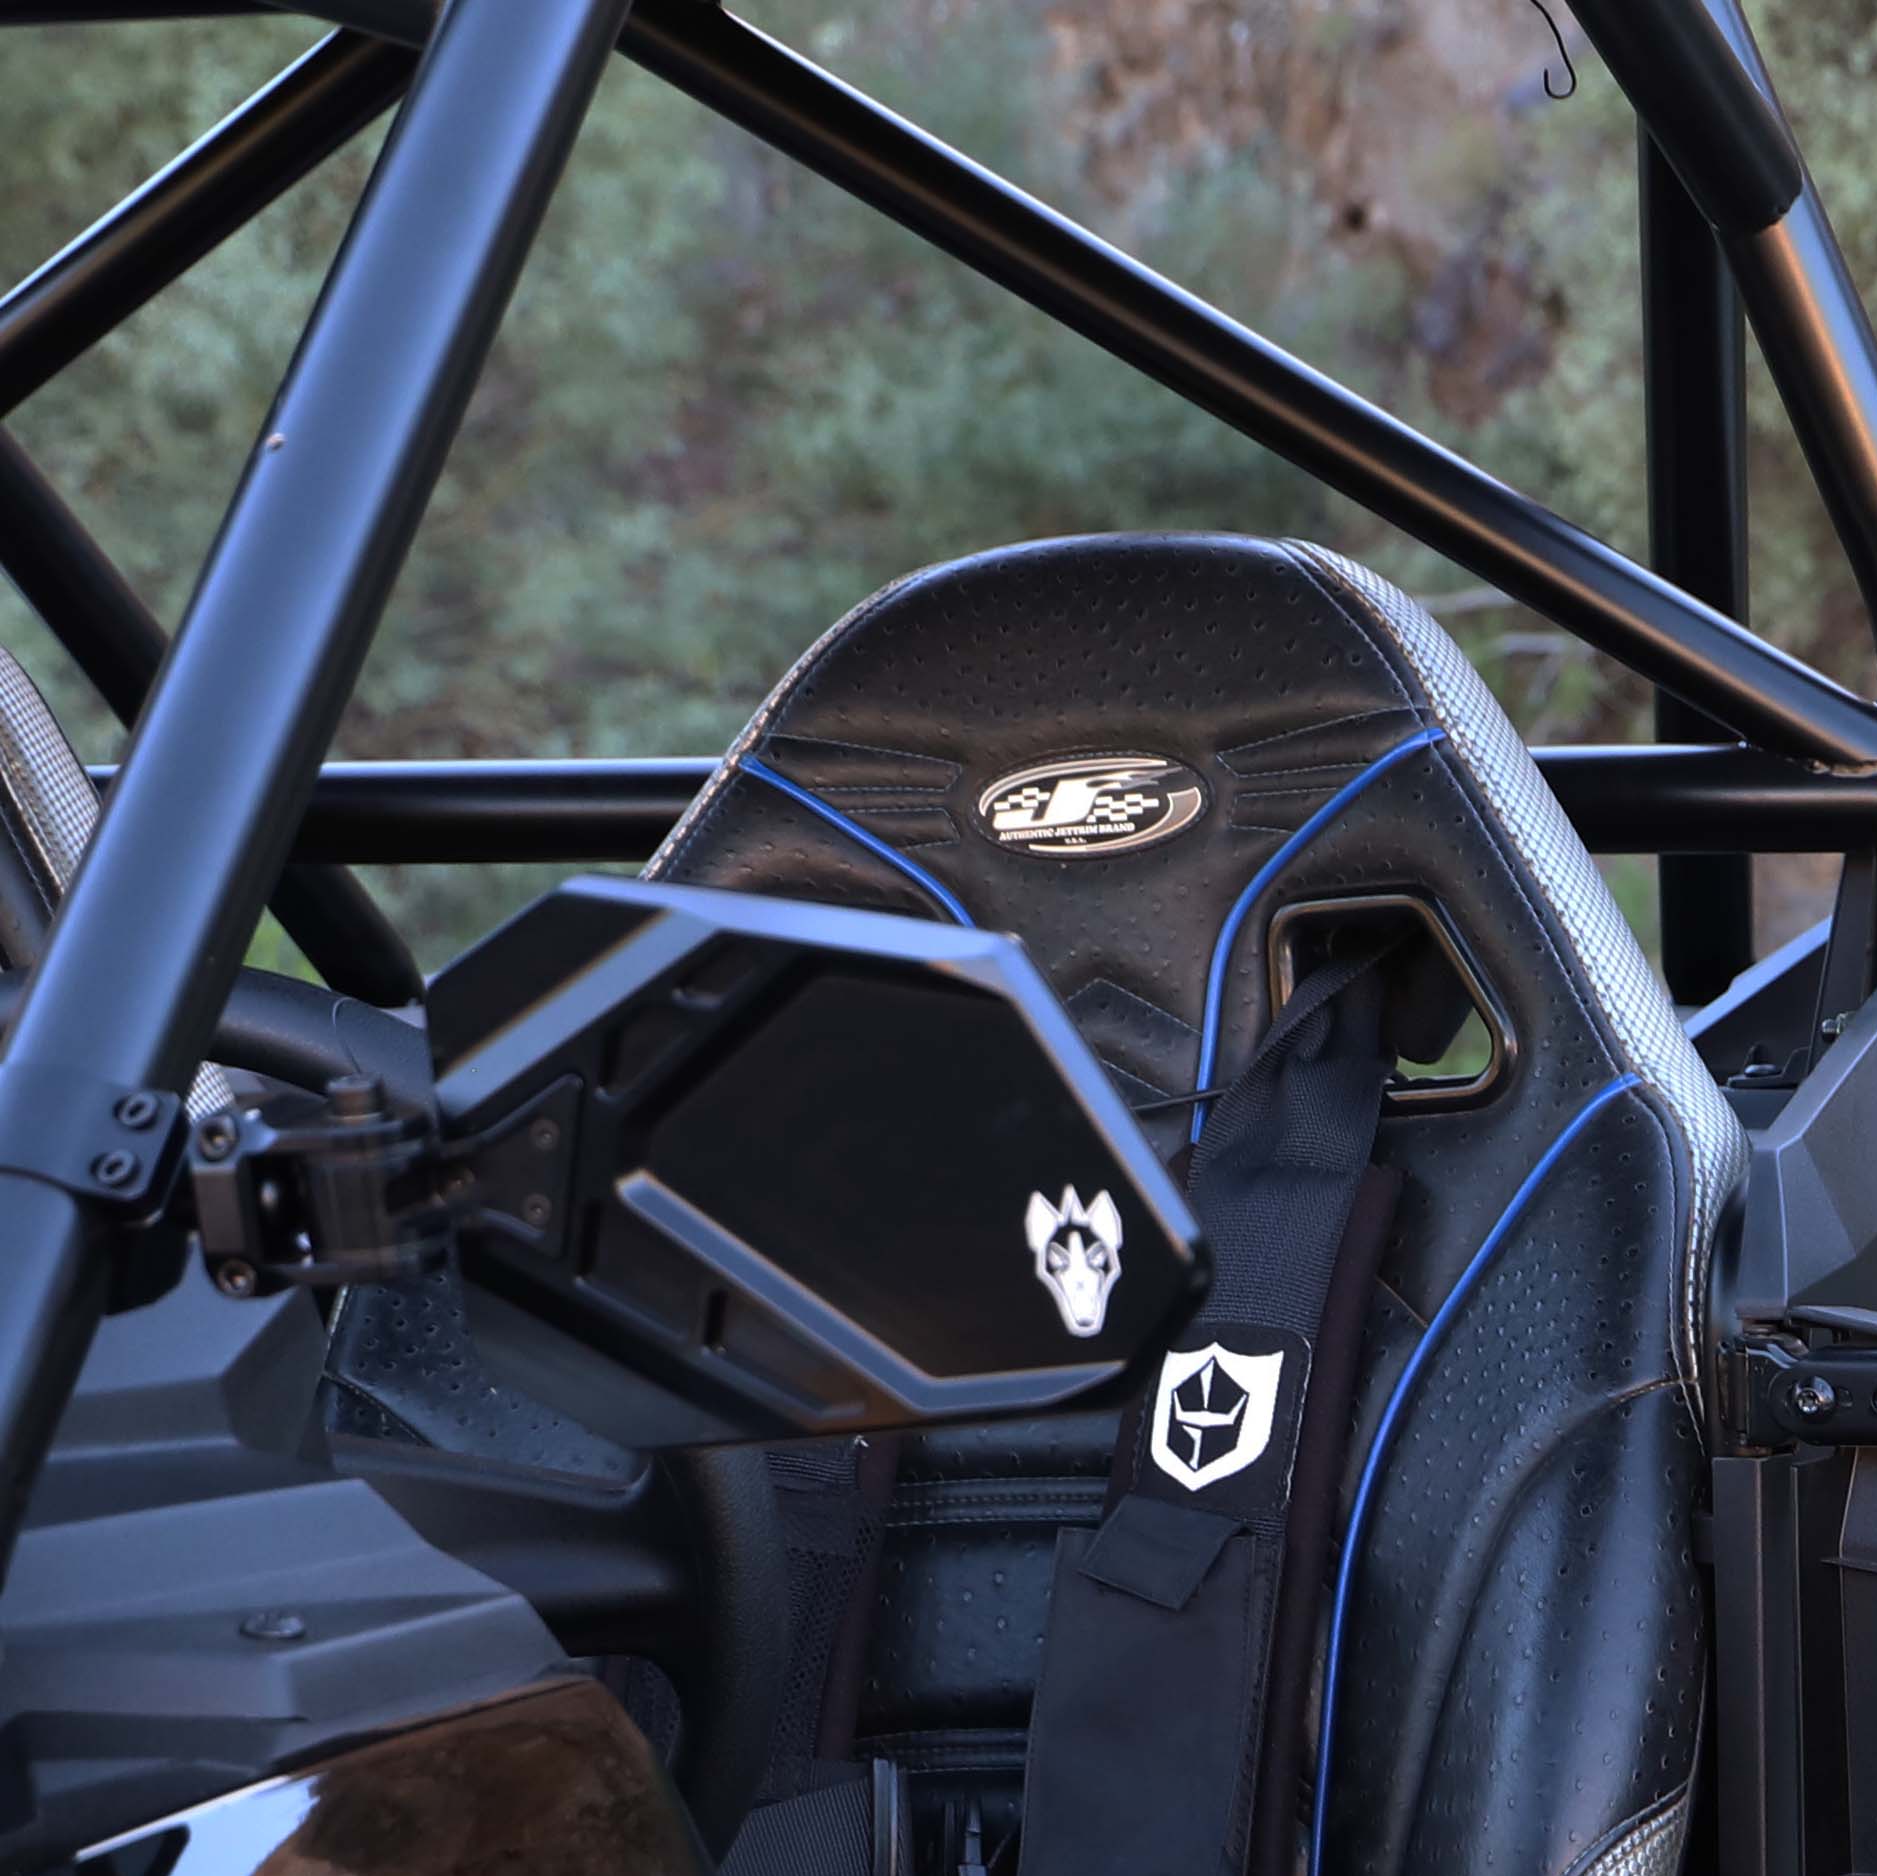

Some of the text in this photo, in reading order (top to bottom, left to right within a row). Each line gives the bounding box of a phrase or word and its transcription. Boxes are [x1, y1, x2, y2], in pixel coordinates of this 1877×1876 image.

[999, 822, 1135, 841] AUTHENTIC JETTRIM BRAND
